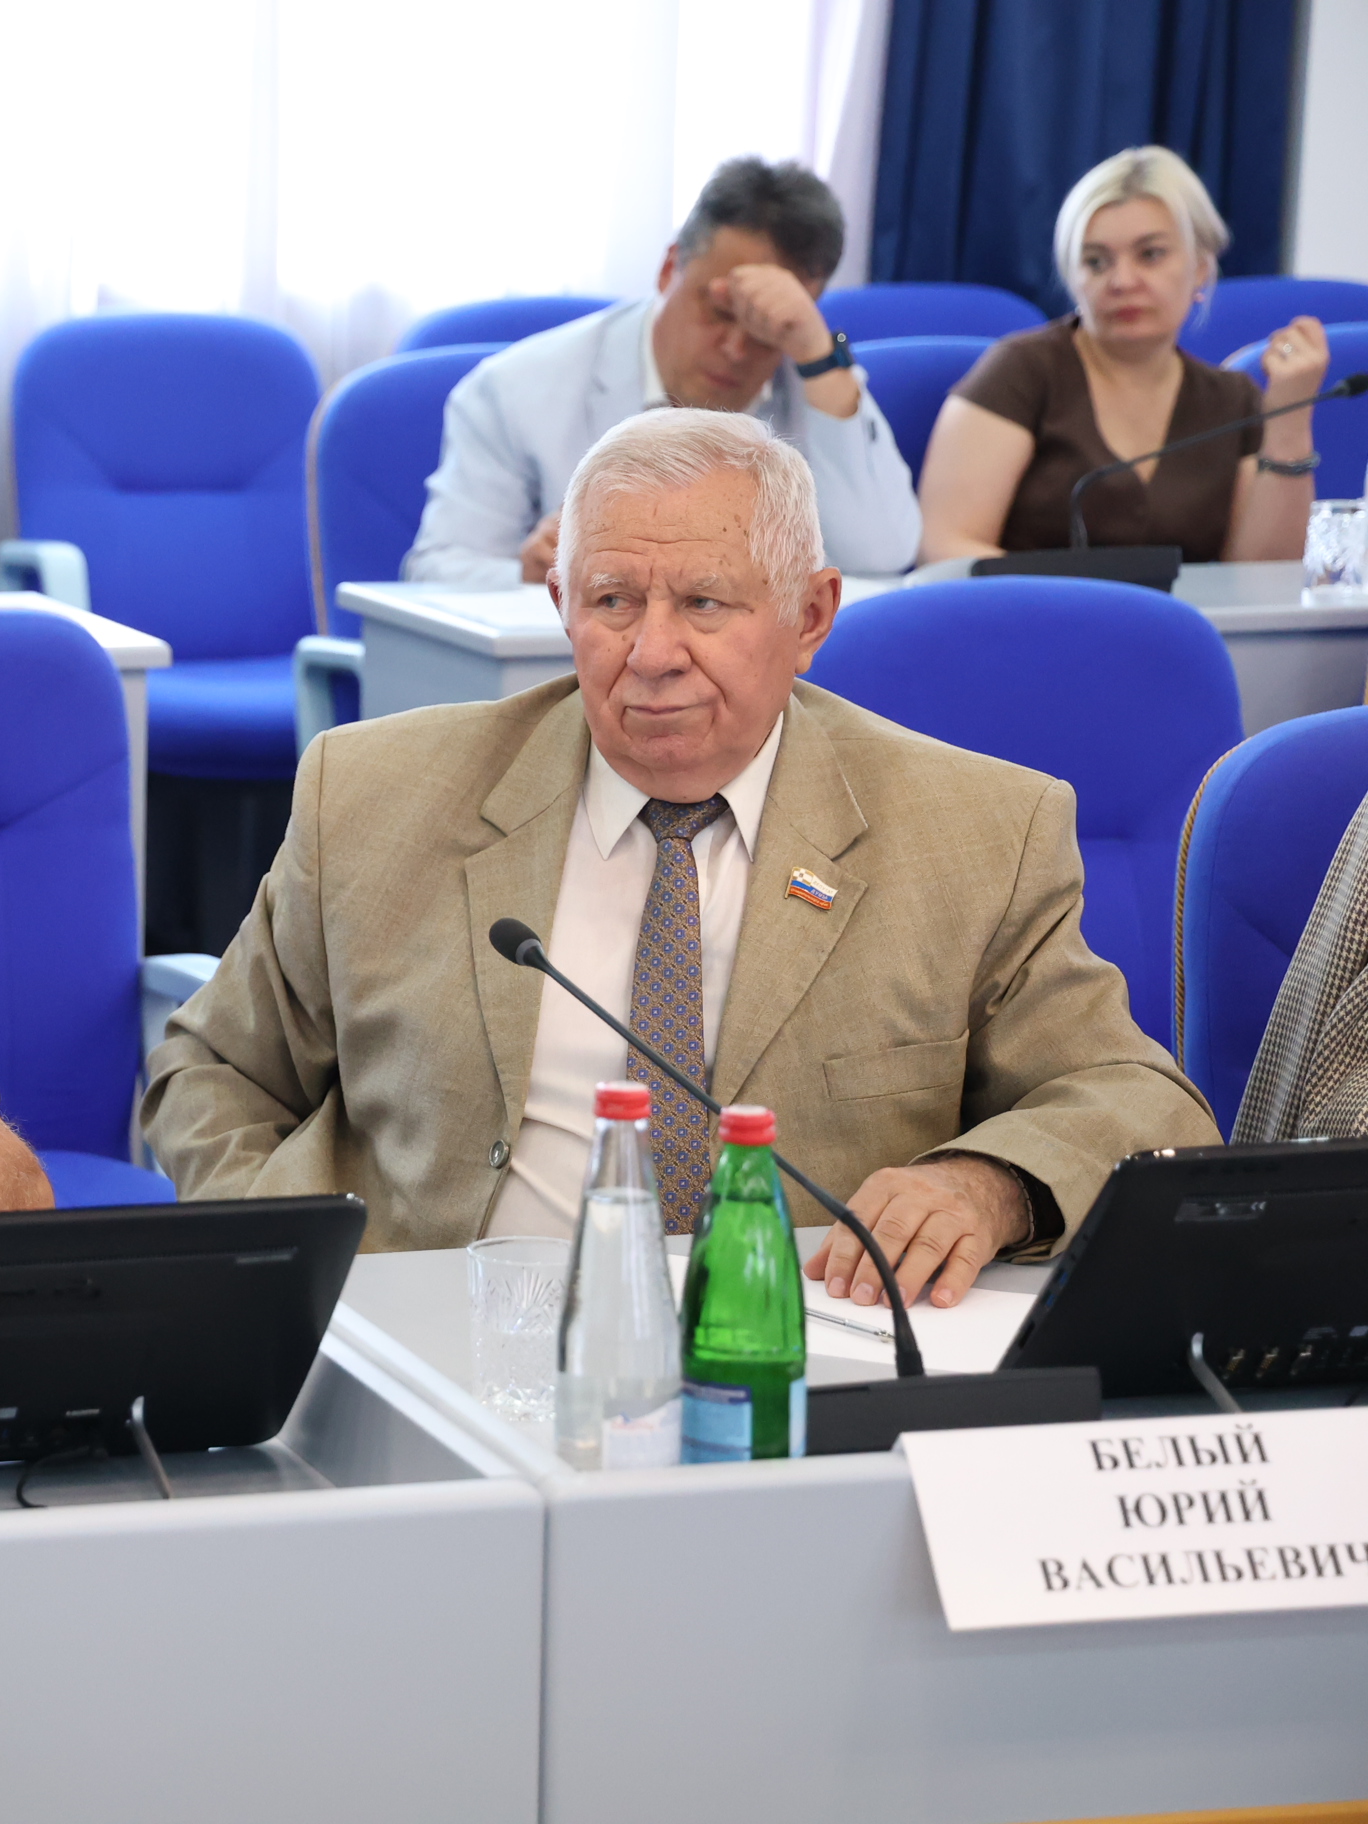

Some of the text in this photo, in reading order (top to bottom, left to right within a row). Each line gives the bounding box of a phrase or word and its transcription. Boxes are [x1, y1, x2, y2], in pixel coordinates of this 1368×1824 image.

[1089, 1423, 1270, 1471] БЕЛЫЙ
[1117, 1479, 1272, 1528] ЮРИЙ
[1039, 1541, 1368, 1592] ВАСИЛЬЕВИЧ
